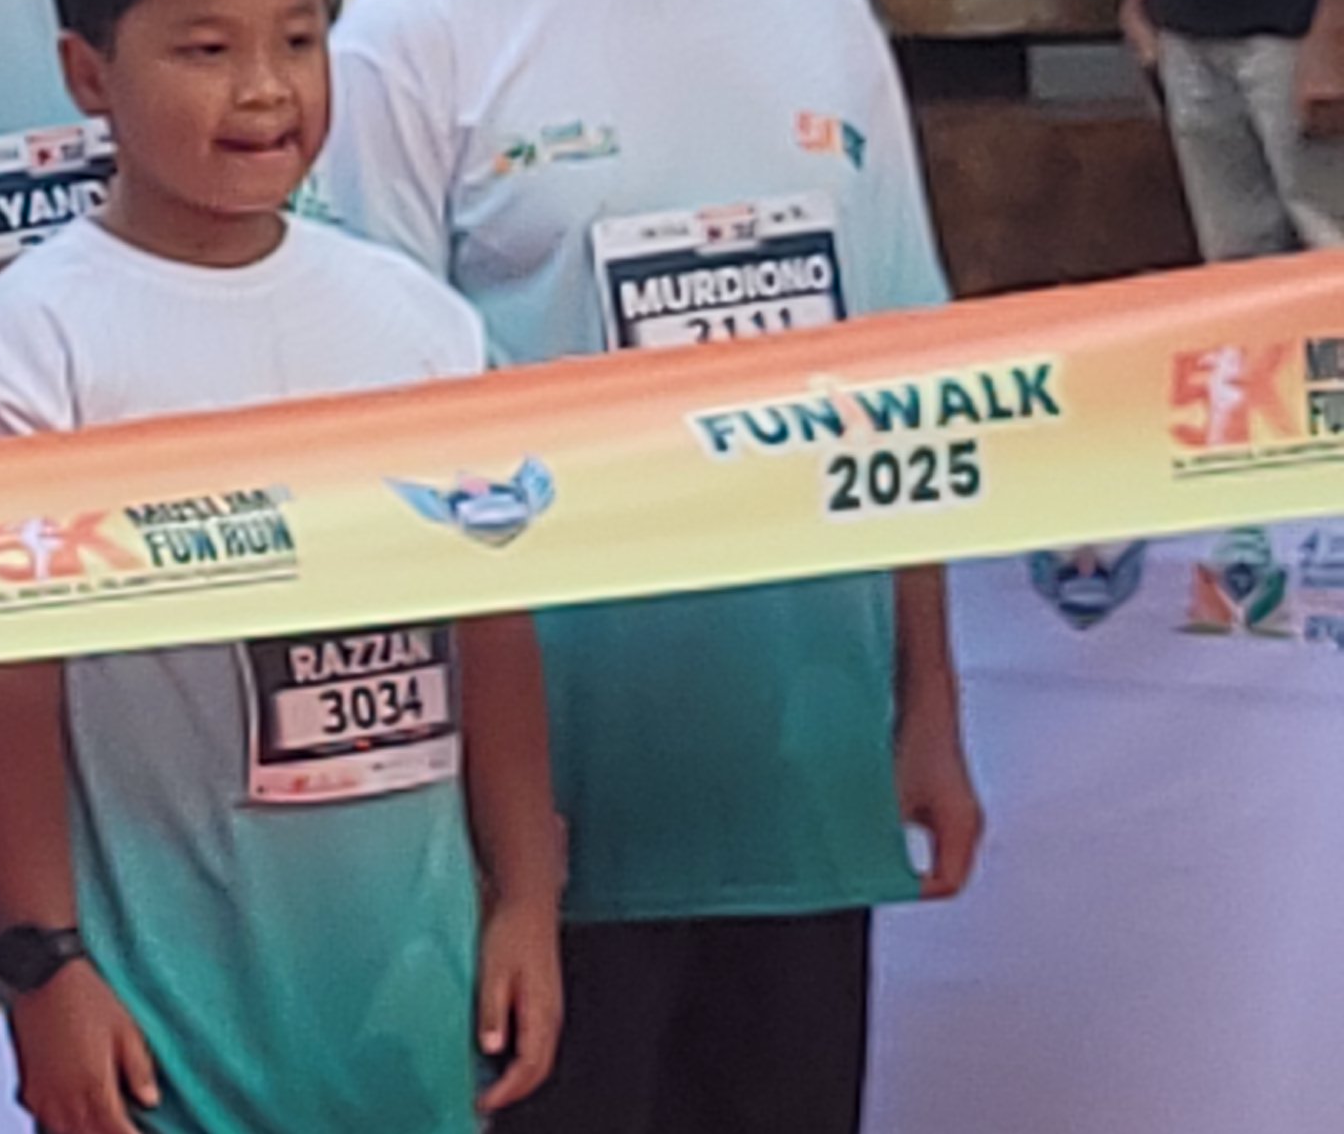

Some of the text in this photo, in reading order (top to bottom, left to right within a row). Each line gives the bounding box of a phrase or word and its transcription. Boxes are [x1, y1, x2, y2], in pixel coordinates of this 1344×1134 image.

[620, 252, 833, 320] MURDIONO
[692, 362, 1062, 453] FUN WALK
[1172, 343, 1304, 449] 5K
[826, 439, 981, 511] 2025
[143, 516, 296, 568] FUN RUN
[318, 676, 423, 735] 3034
